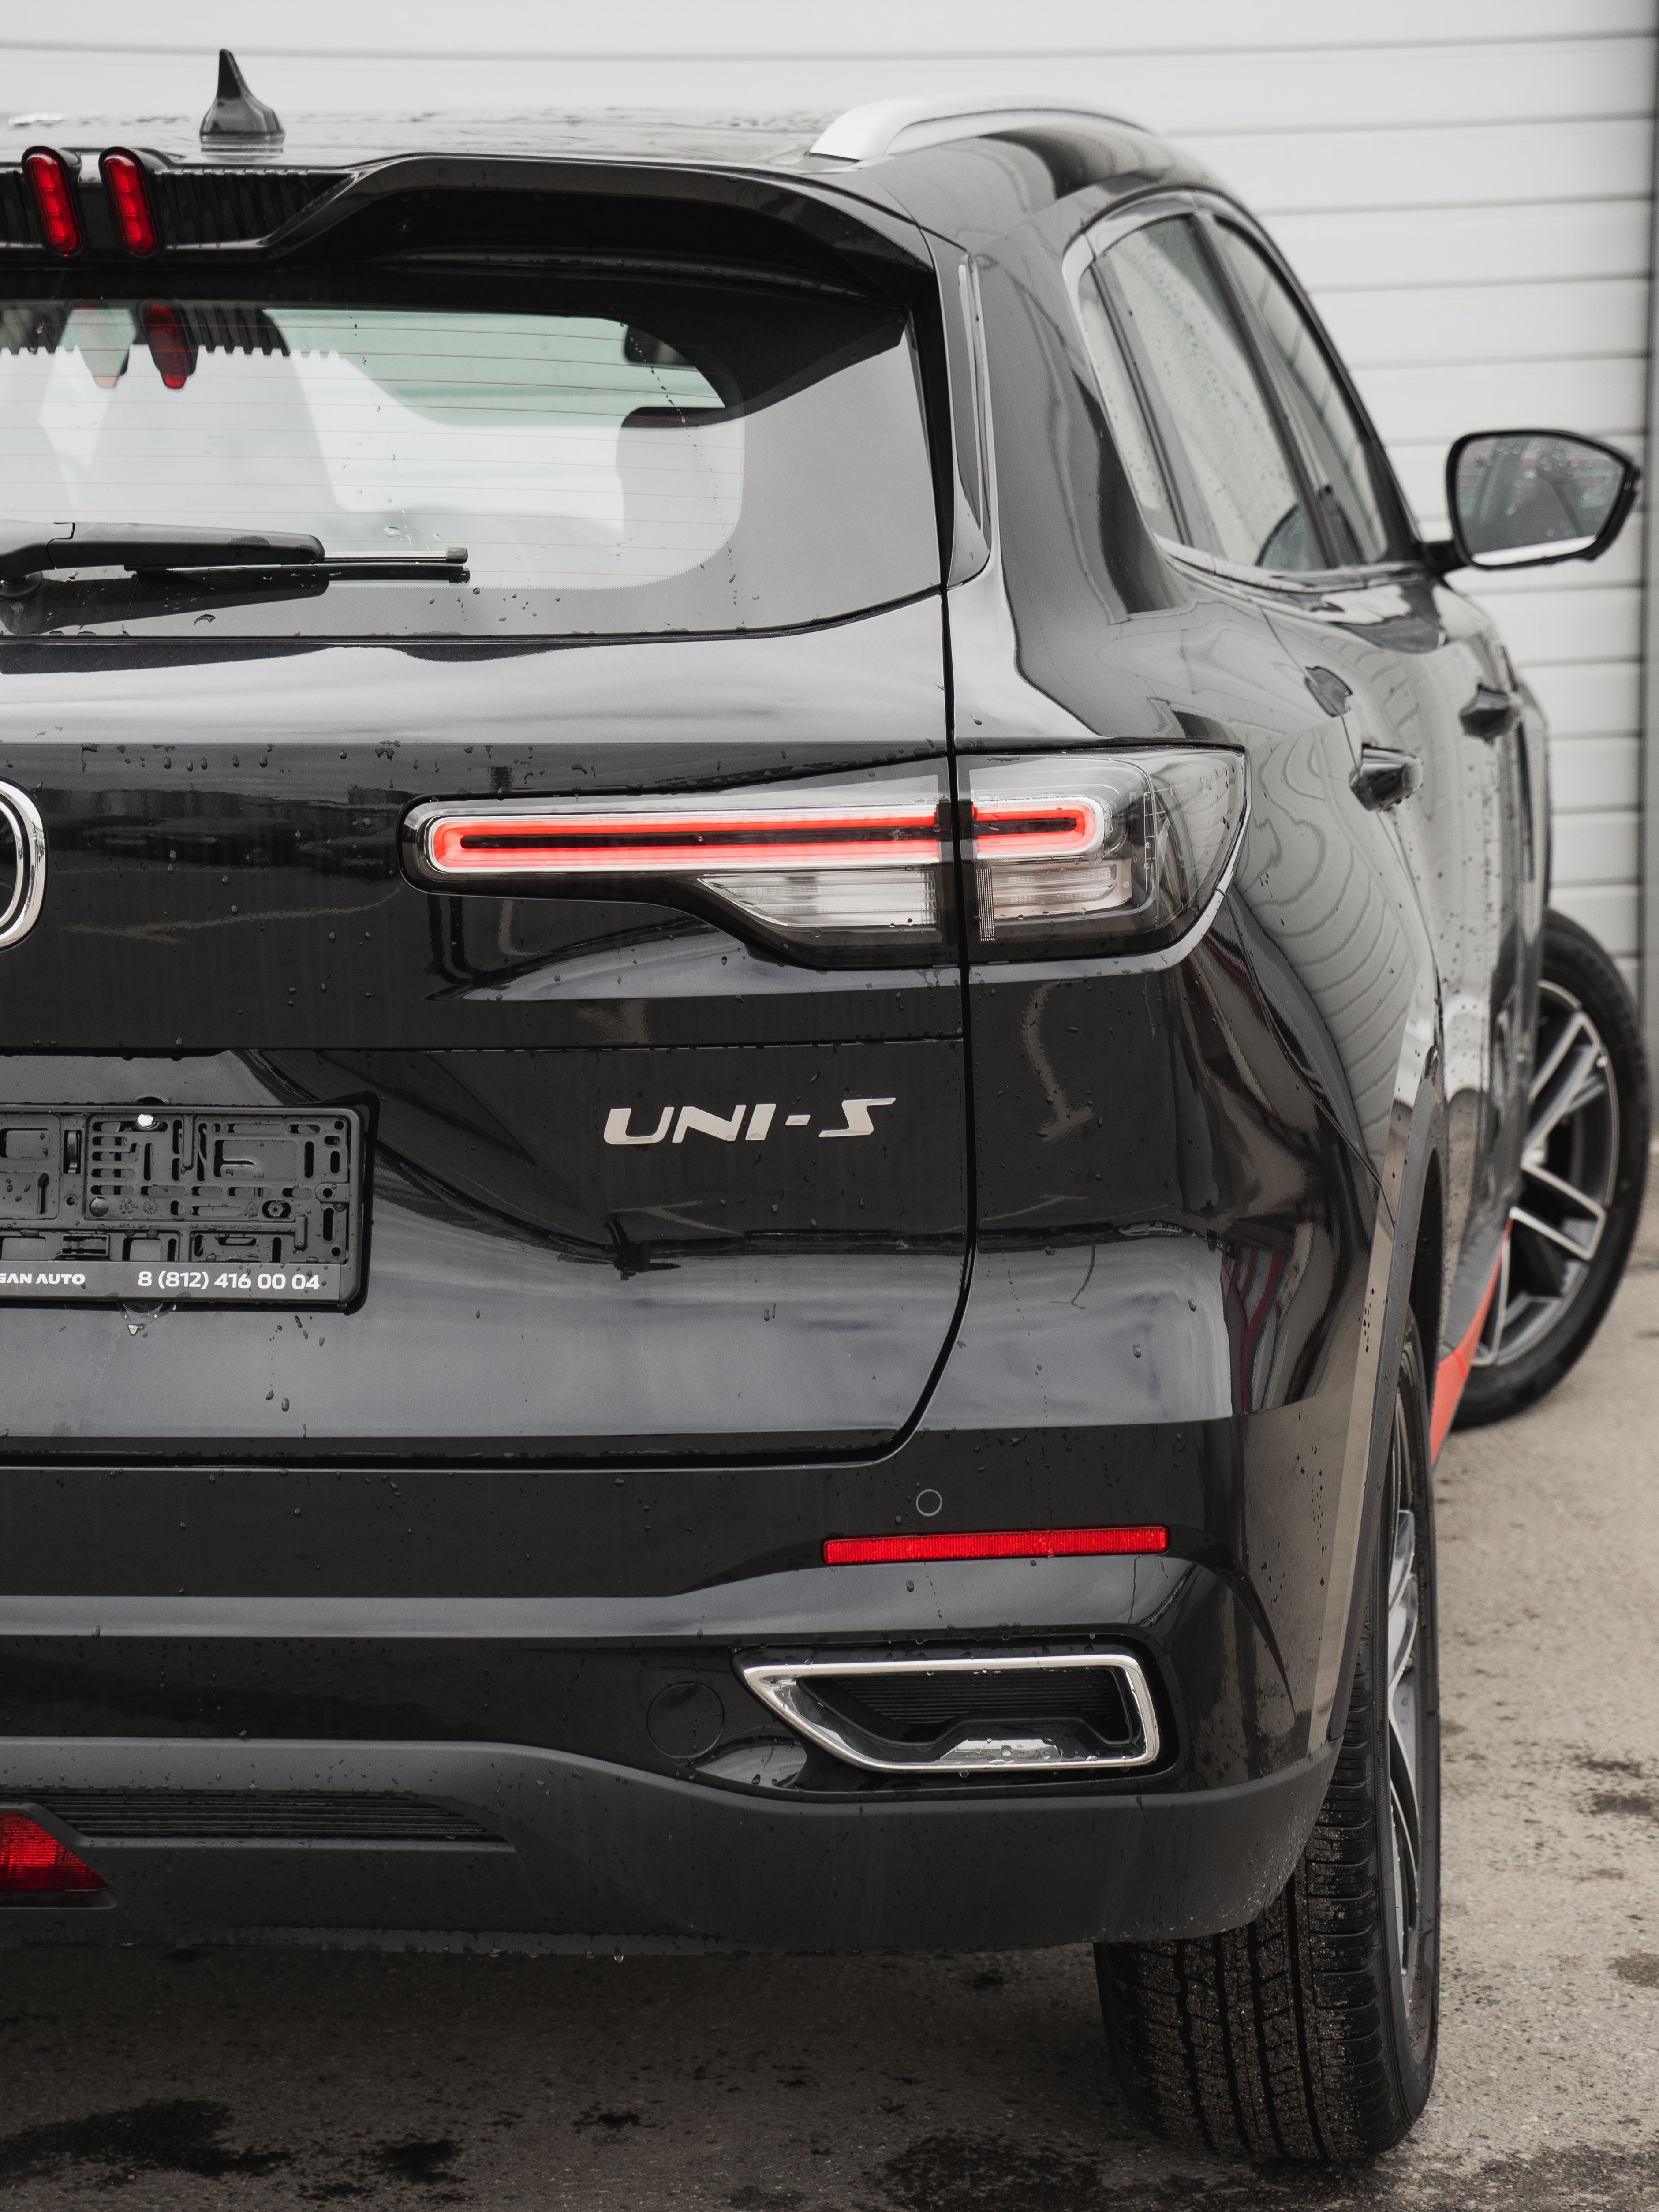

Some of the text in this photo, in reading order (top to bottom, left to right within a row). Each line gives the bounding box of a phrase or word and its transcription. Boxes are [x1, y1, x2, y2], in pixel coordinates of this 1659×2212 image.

[604, 1098, 896, 1144] UNI-S
[36, 1274, 85, 1285] AUTO
[138, 1271, 320, 1289] 8 (812) 416 00 04
